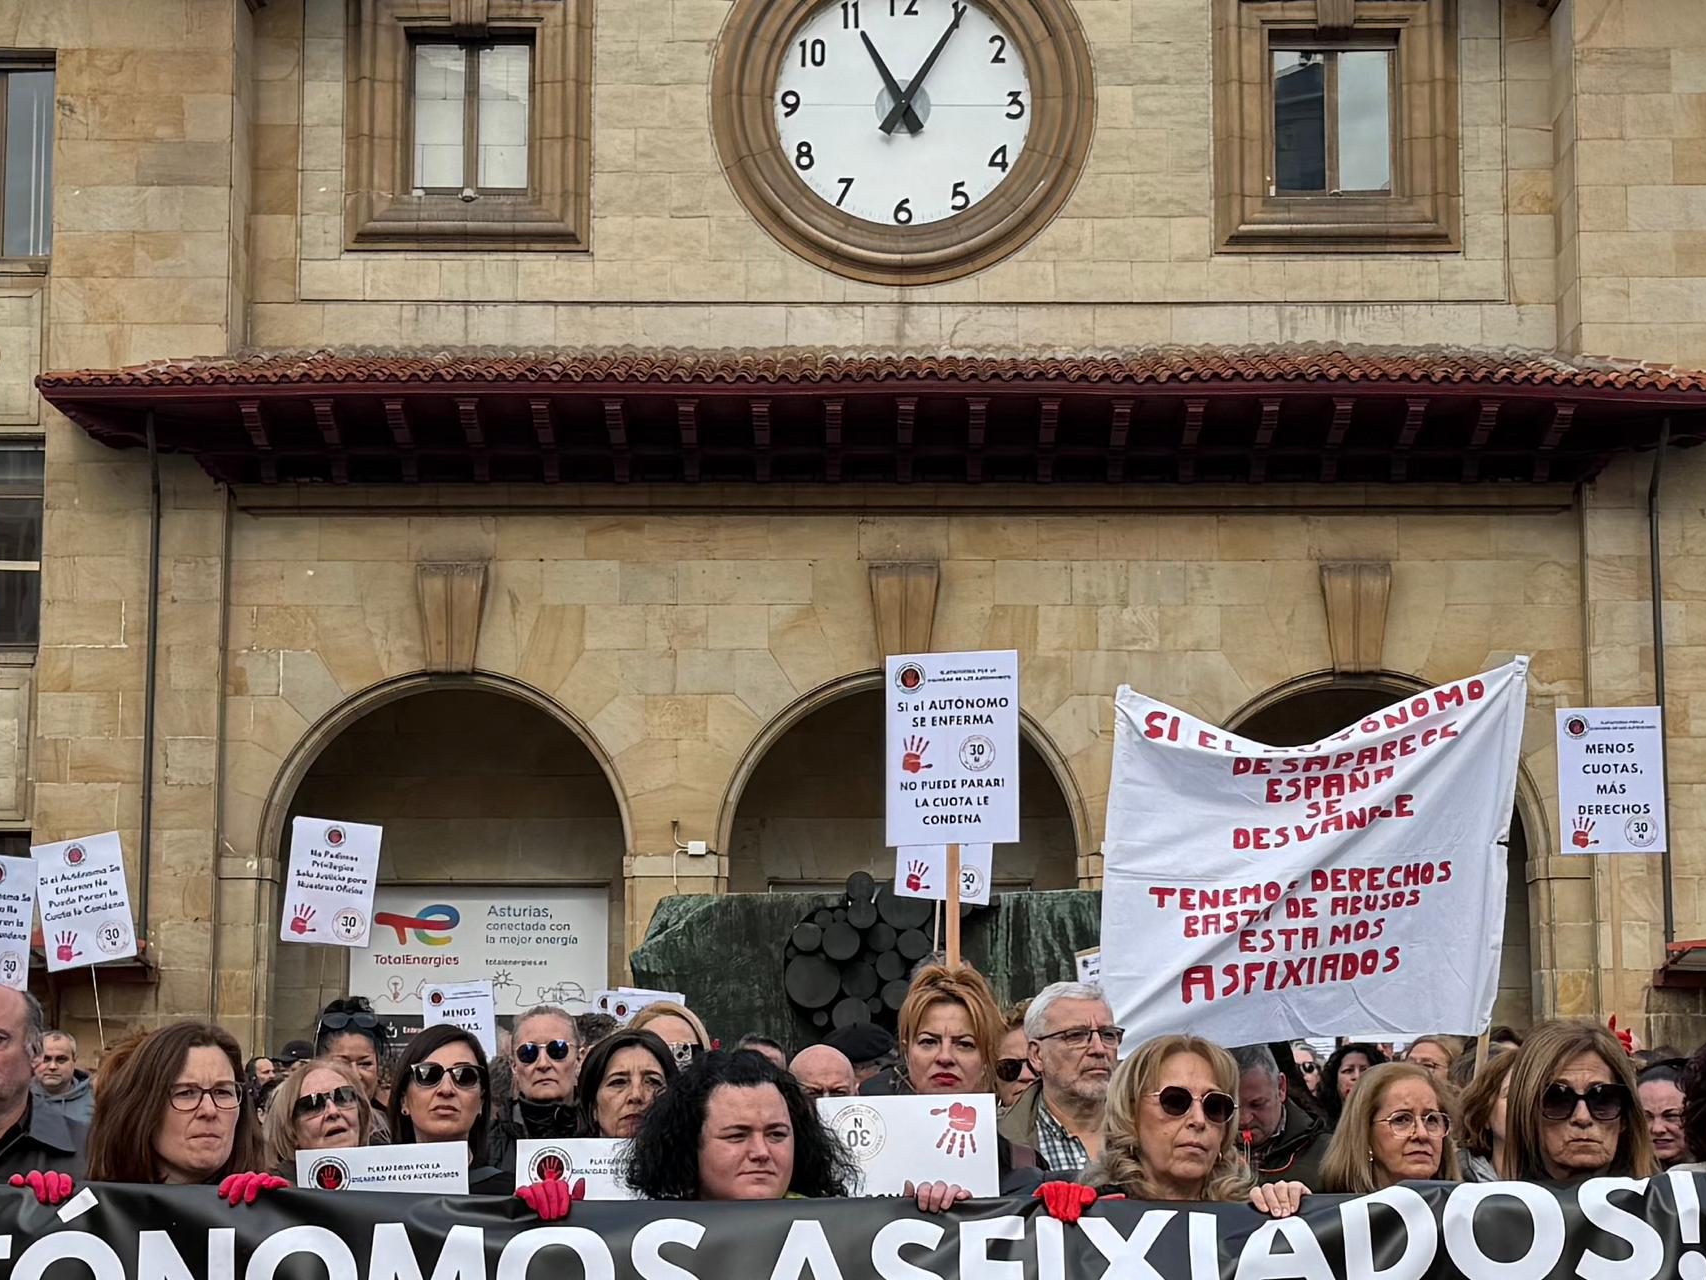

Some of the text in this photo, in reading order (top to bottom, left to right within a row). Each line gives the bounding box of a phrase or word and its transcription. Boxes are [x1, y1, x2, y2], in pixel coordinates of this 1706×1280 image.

[841, 0, 860, 29] 11
[799, 39, 826, 67] 10
[989, 35, 1006, 63] 2
[781, 90, 801, 118] 9
[1005, 91, 1025, 120] 3
[795, 141, 815, 171] 8
[988, 144, 1009, 172] 4
[835, 178, 854, 207] 7
[951, 181, 970, 211] 5
[893, 197, 913, 225] 6
[928, 696, 1009, 710] AUTÓNOMO
[931, 714, 994, 727] ENFERMA
[1143, 710, 1181, 743] SI
[969, 744, 985, 756] 30
[1232, 720, 1461, 776] DESAPARECE
[1585, 743, 1635, 754] MENOS
[1582, 763, 1643, 775] CUOTAS,
[900, 781, 917, 791] NO
[921, 779, 956, 790] PUEDE
[1265, 765, 1395, 803] ESPAÑA
[1596, 781, 1627, 795] MÁS
[915, 796, 989, 808] LA CUOTA LE
[1305, 799, 1343, 819] SE
[1577, 803, 1651, 816] DERECHOS
[922, 814, 981, 825] CONDENA
[1633, 822, 1648, 833] 30
[1310, 860, 1453, 893] DERECHOS
[487, 905, 553, 920] Asturias,
[1285, 895, 1319, 921] DE
[1330, 888, 1421, 917] ABUSOS
[341, 916, 357, 928] 30
[486, 922, 571, 931] conectada con
[104, 928, 120, 941] 30
[485, 934, 578, 946] la mejor energía
[373, 954, 459, 968] TotalEnergies
[1180, 945, 1400, 1005] ASFIXIADOS
